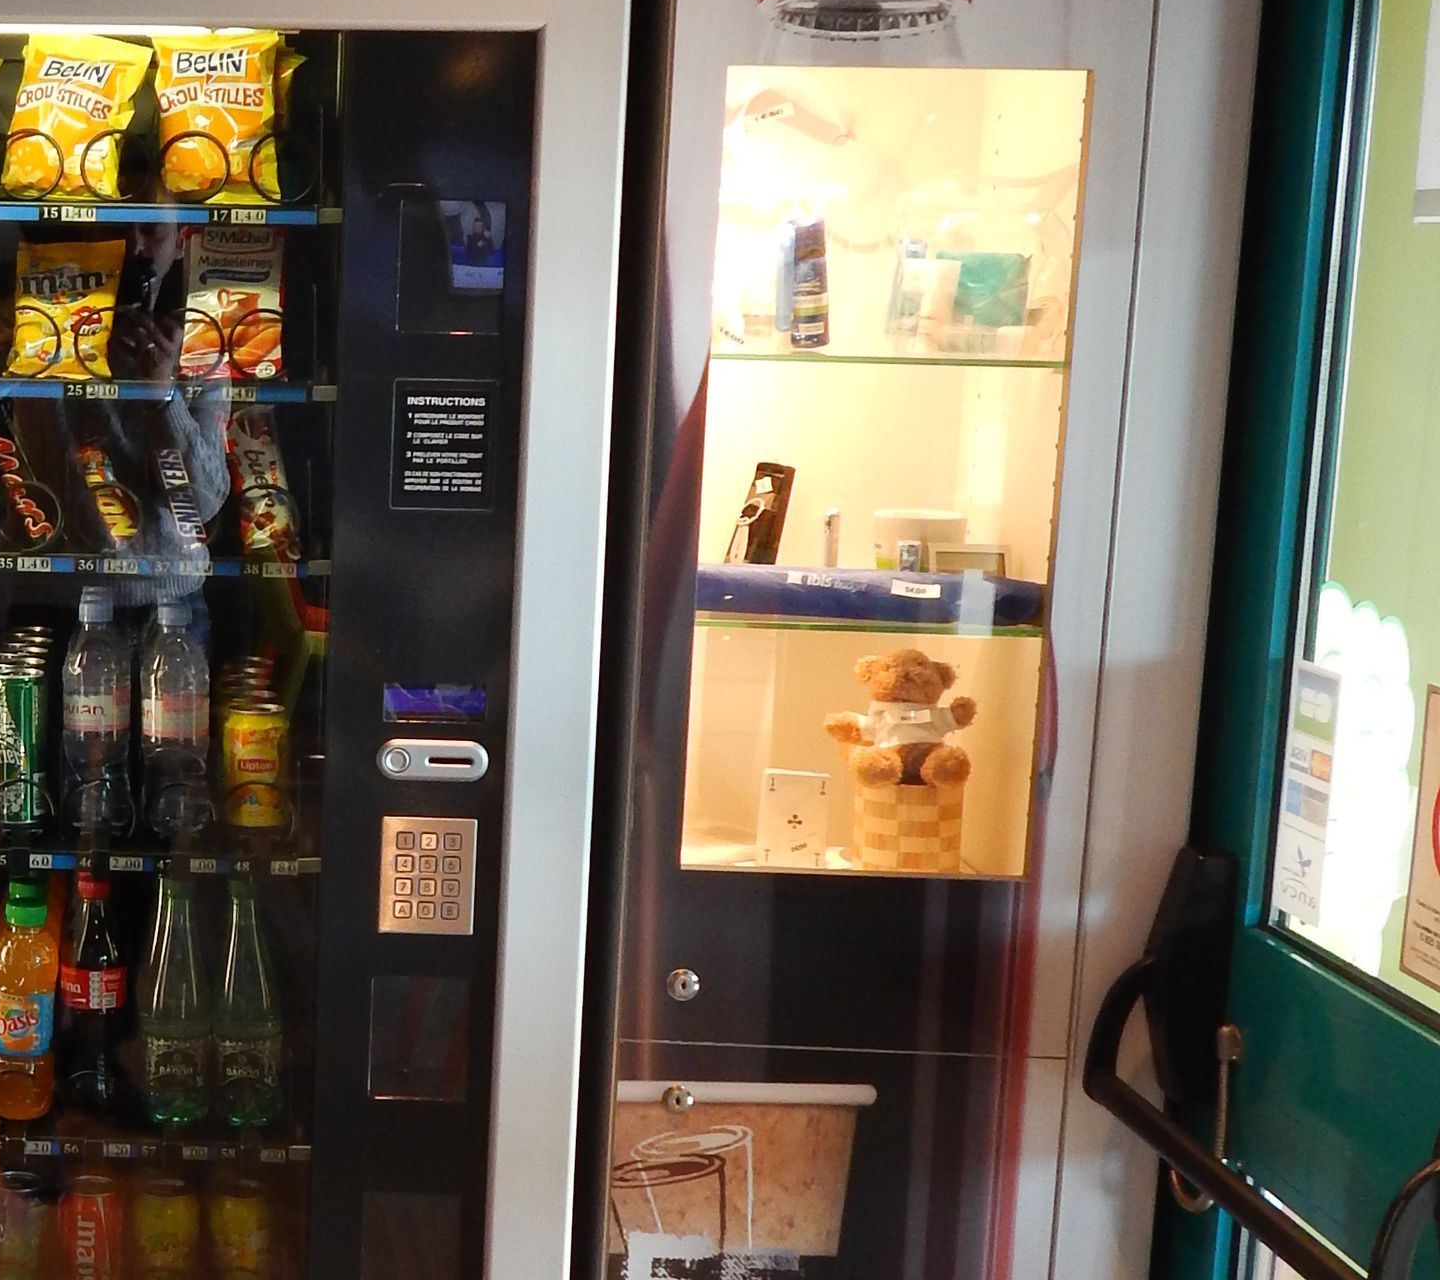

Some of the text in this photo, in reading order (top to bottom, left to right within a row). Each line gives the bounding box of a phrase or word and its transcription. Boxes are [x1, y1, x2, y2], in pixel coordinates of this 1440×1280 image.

[42, 206, 59, 219] 15
[211, 208, 228, 221] 17
[66, 384, 83, 397] 25
[185, 386, 202, 398] 27
[406, 396, 486, 407] INSTRUCTIONS
[78, 558, 95, 571] 36
[239, 759, 273, 771] Lipton
